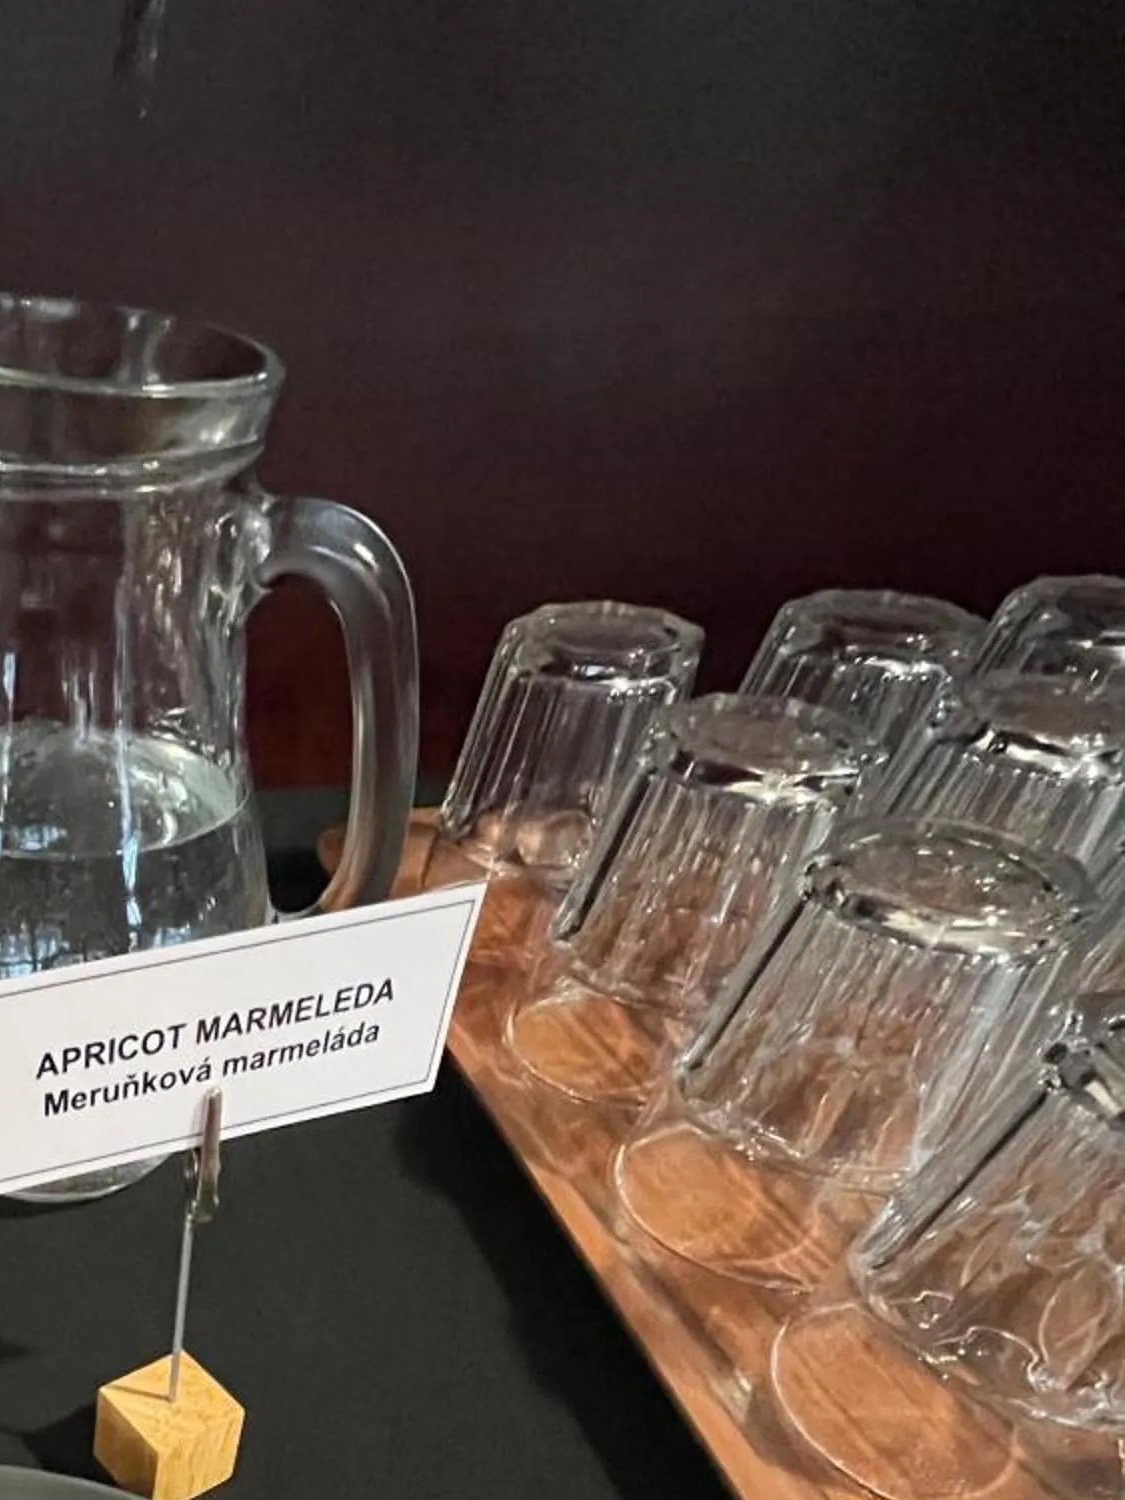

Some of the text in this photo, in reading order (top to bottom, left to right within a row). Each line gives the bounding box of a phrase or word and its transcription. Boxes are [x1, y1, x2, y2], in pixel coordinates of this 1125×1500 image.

[35, 978, 394, 1079] APRICOT MARMELEDA
[43, 1022, 380, 1117] Meruňková marmeláda
